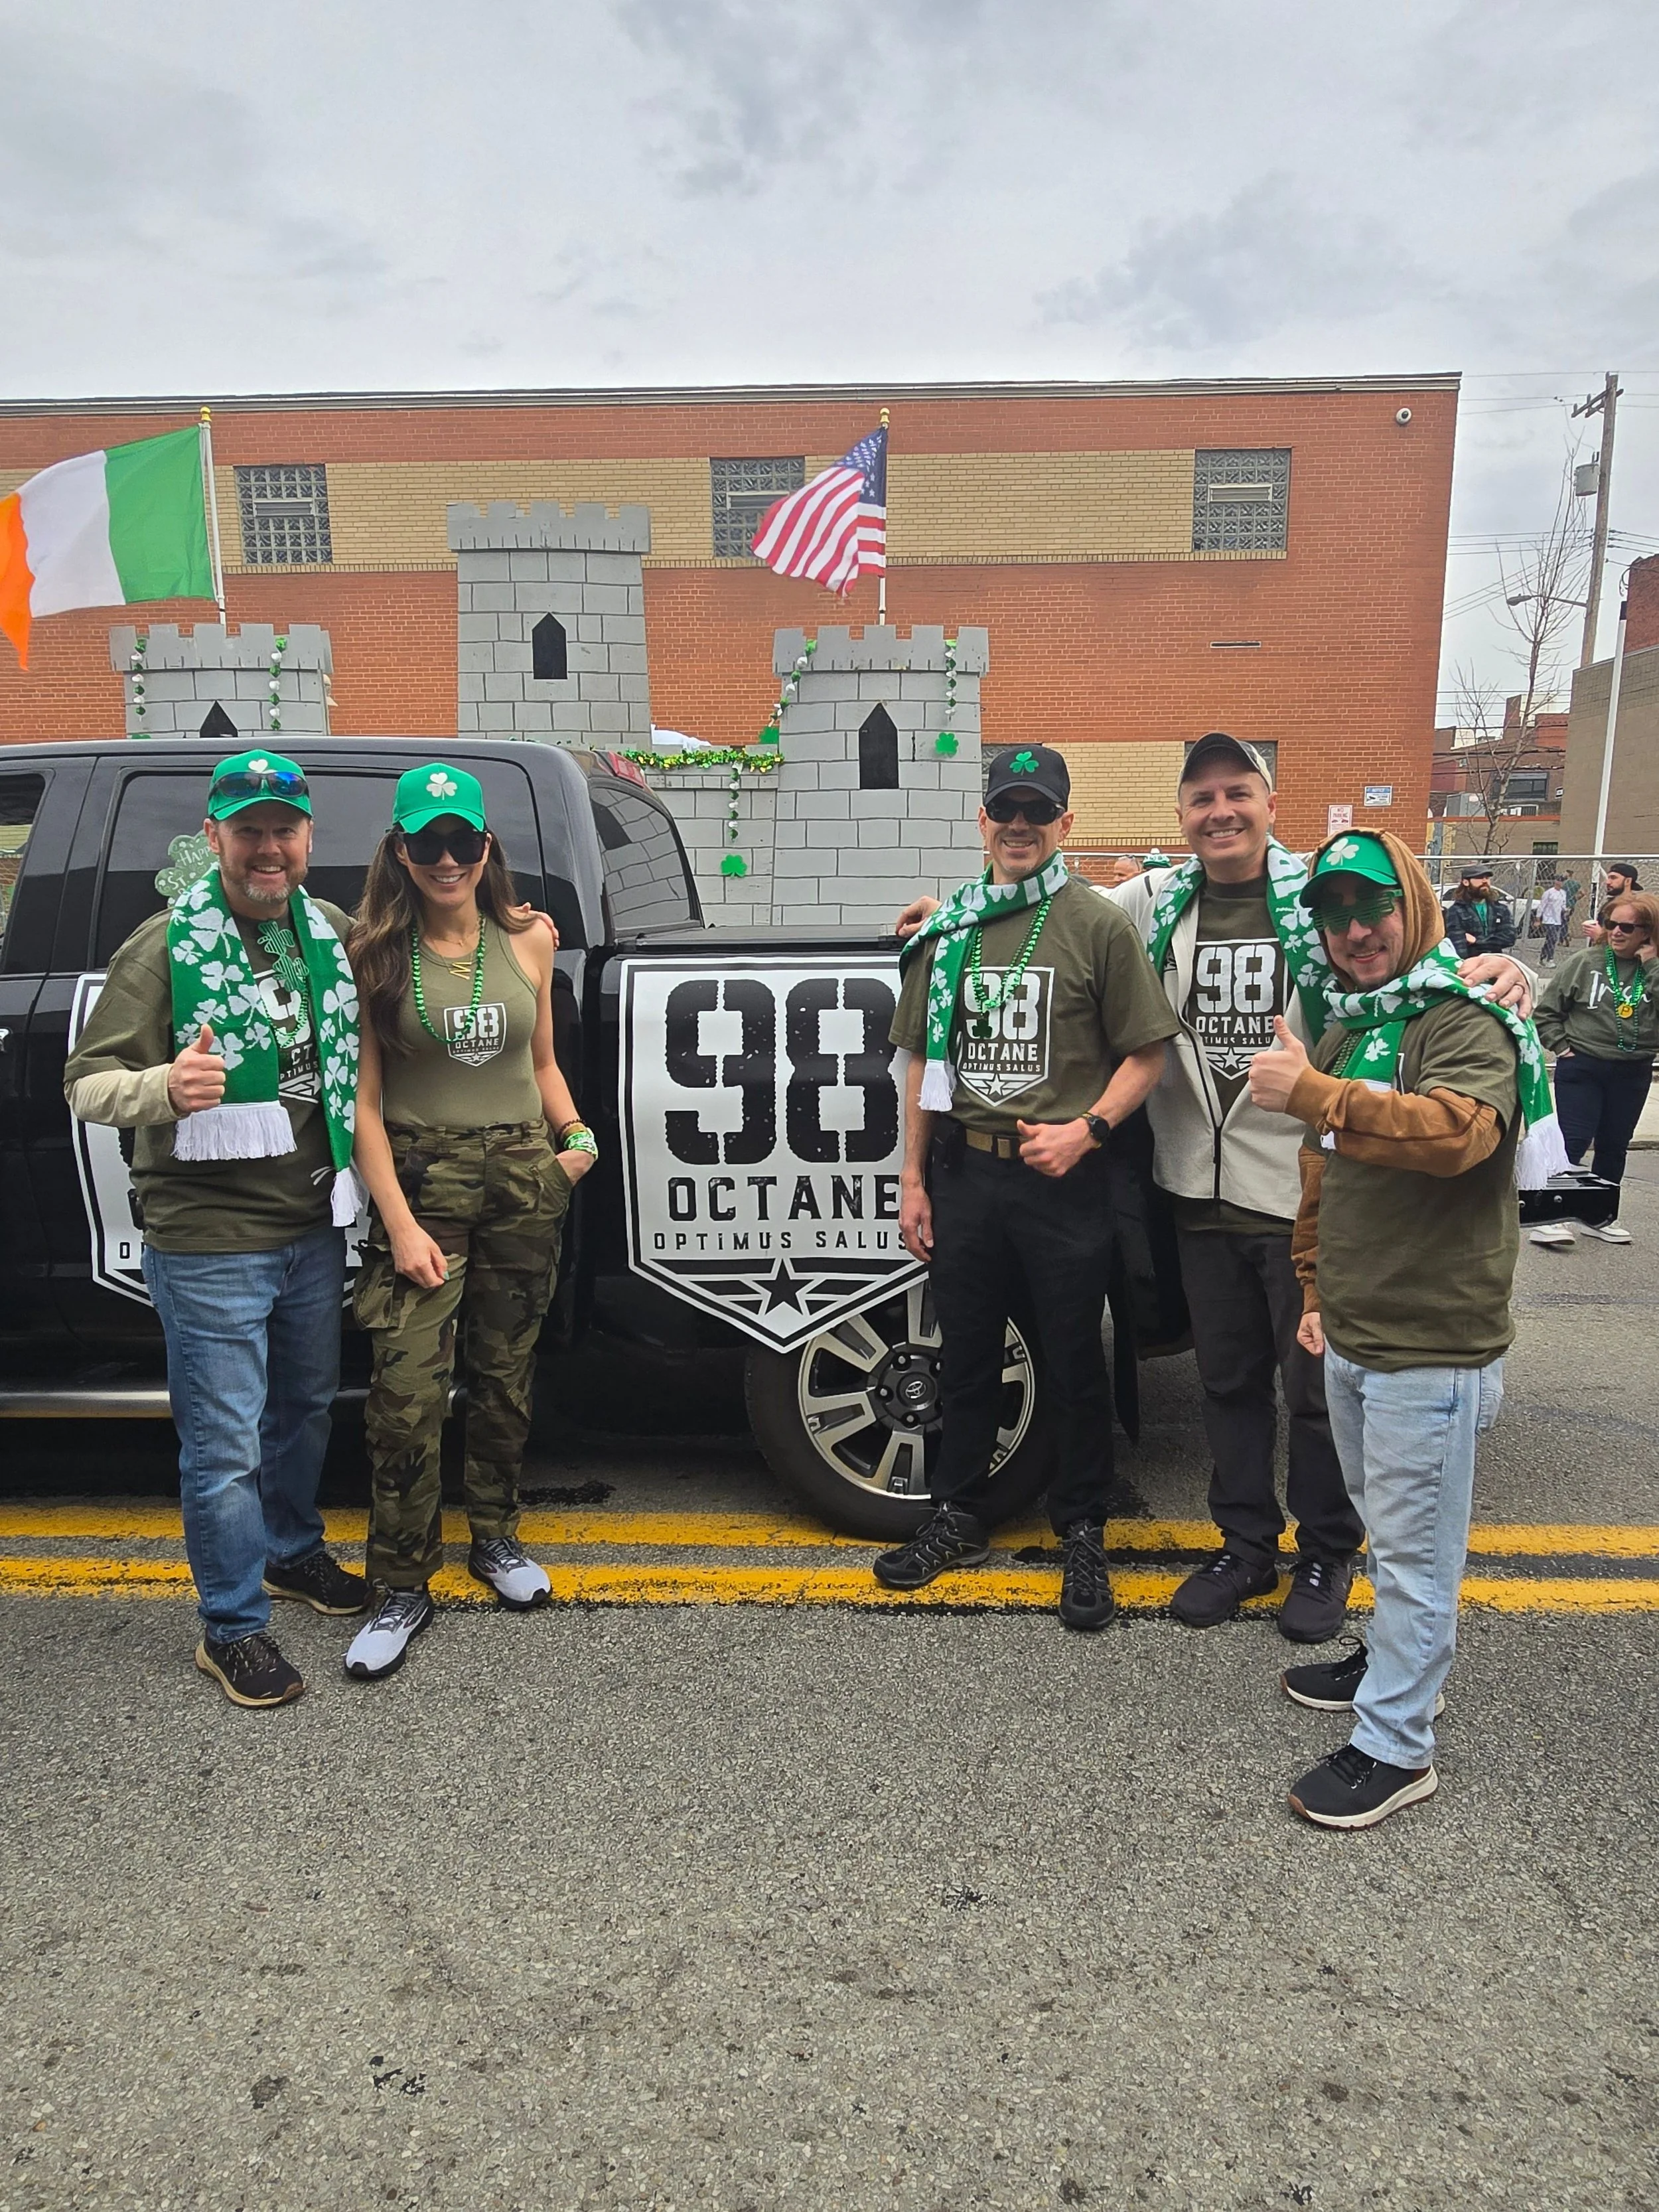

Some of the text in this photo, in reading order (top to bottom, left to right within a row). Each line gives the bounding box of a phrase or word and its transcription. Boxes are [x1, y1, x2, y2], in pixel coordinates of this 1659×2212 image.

[179, 846, 210, 866] HAPP
[1196, 944, 1276, 1013] 98
[964, 972, 1041, 1040] 98
[453, 1007, 500, 1041] 98
[1196, 1015, 1274, 1034] OCTANE
[455, 1038, 500, 1049] OCTANE
[1204, 1036, 1271, 1045] TIMUS SALU
[968, 1043, 1038, 1061] OCTANE
[279, 1062, 319, 1080] PTIMUS
[665, 978, 899, 1165] 98
[962, 1063, 1001, 1071] OPTIMUS
[668, 1174, 900, 1221] OCTANE
[654, 1232, 792, 1250] OPTIMUS
